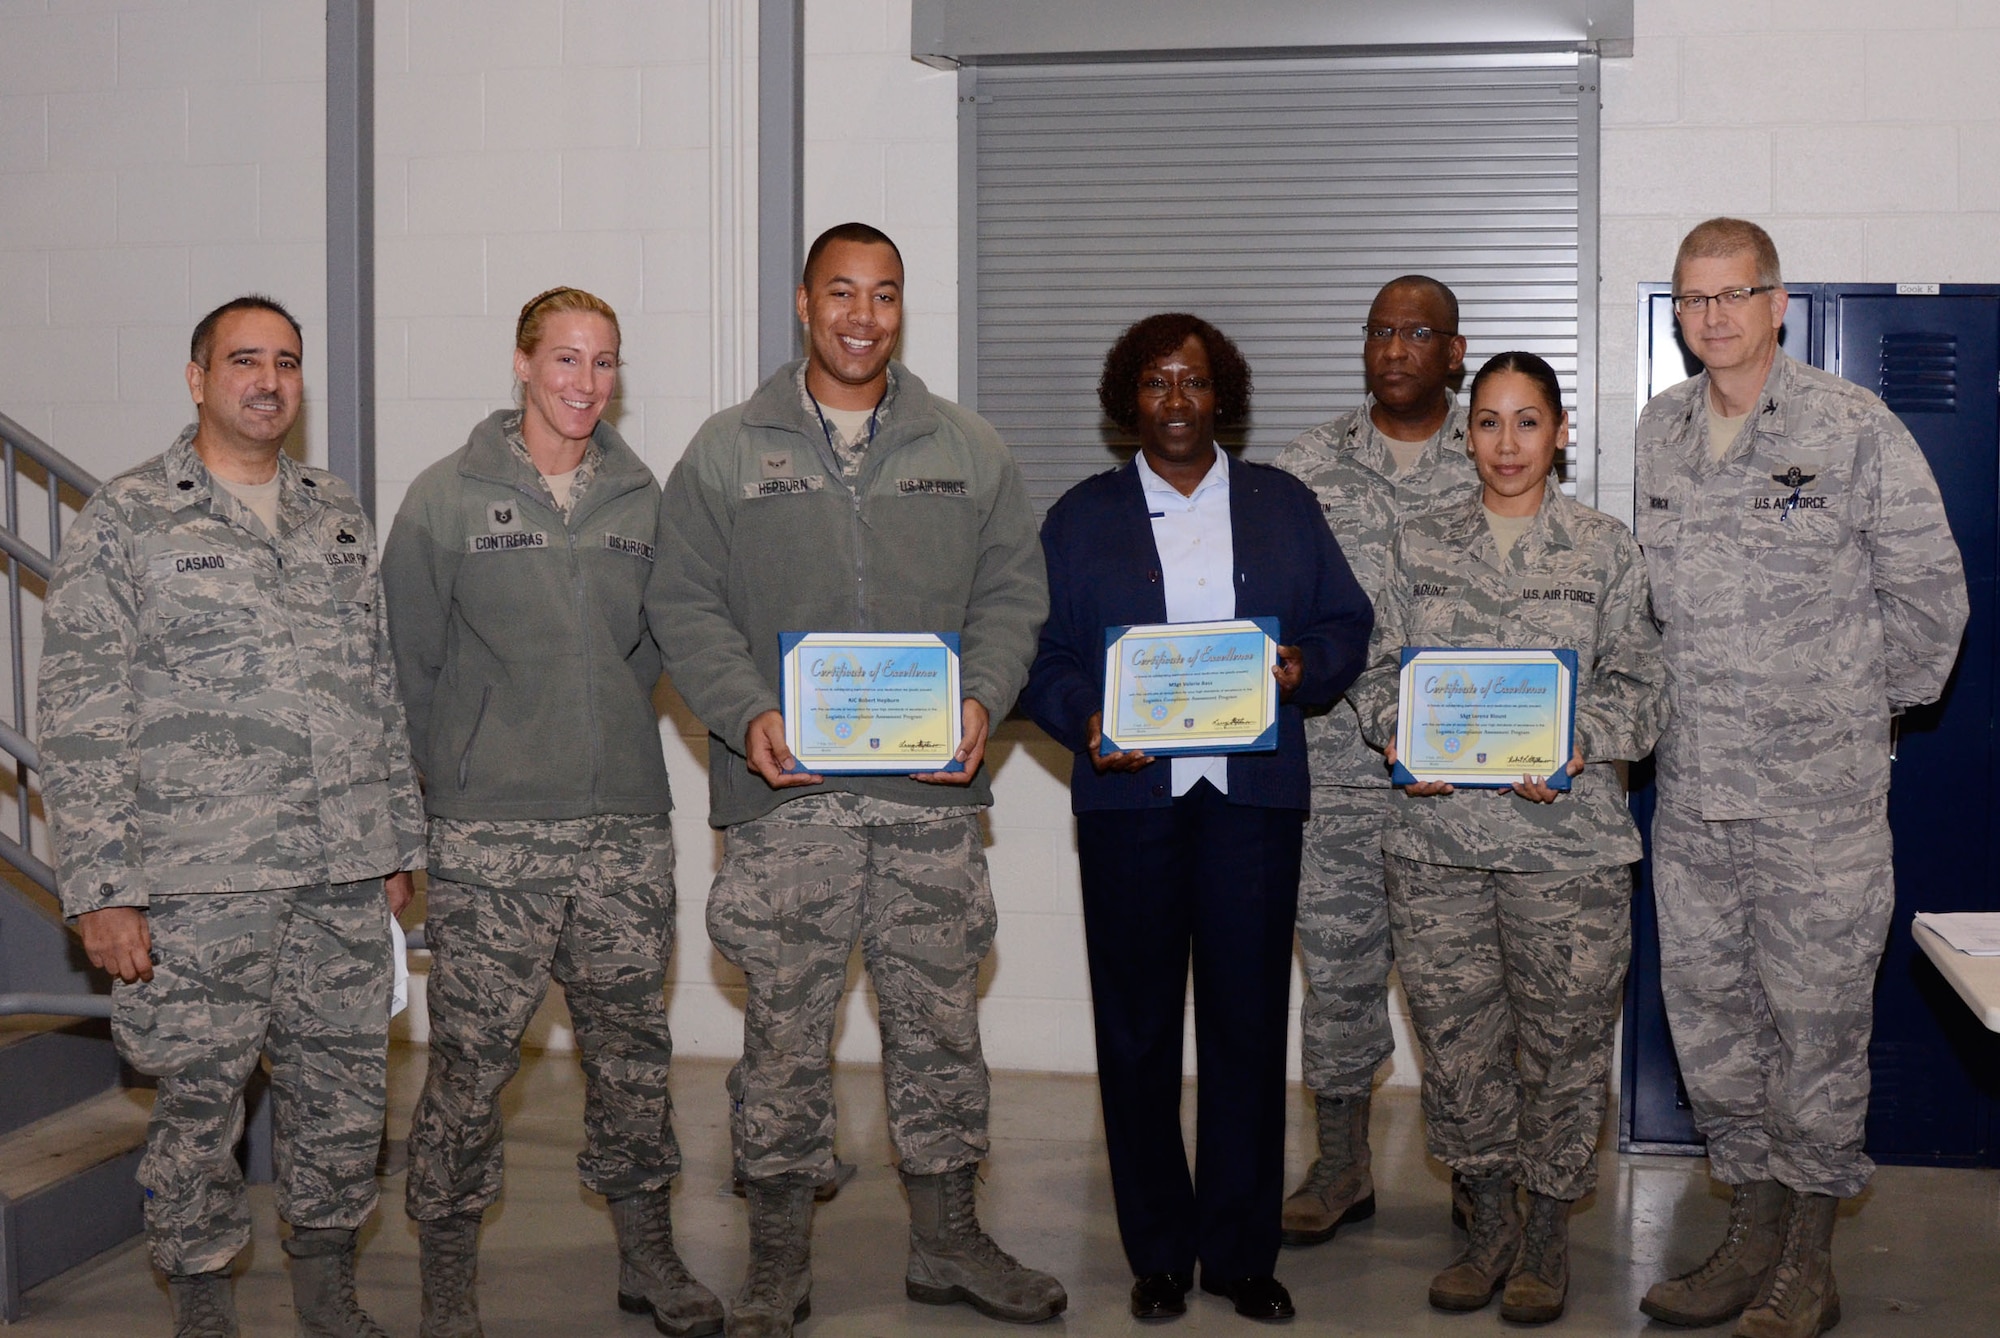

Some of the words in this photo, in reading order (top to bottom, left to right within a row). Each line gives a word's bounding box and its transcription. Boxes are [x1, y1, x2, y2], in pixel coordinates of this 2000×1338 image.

[1900, 285, 1923, 293] Cook
[759, 479, 808, 494] HEPBURN
[919, 480, 934, 492] AIR
[936, 481, 966, 493] FORCE
[1754, 496, 1772, 509] U.S.
[1793, 496, 1828, 509] ORCE
[475, 534, 543, 550] CONTRERAS
[176, 555, 225, 573] CASADO
[1523, 588, 1541, 600] U.S.
[1543, 589, 1561, 601] AIR
[1563, 589, 1596, 604] FORCE
[1131, 648, 1184, 669] Certificate
[1187, 649, 1200, 667] of
[1200, 645, 1254, 664] Excellence
[810, 658, 866, 682] Certificate
[869, 661, 882, 682] of
[881, 659, 938, 679] Excellence
[1424, 676, 1477, 698] Certificate
[1480, 679, 1492, 698] of
[1493, 676, 1547, 694] Excellence
